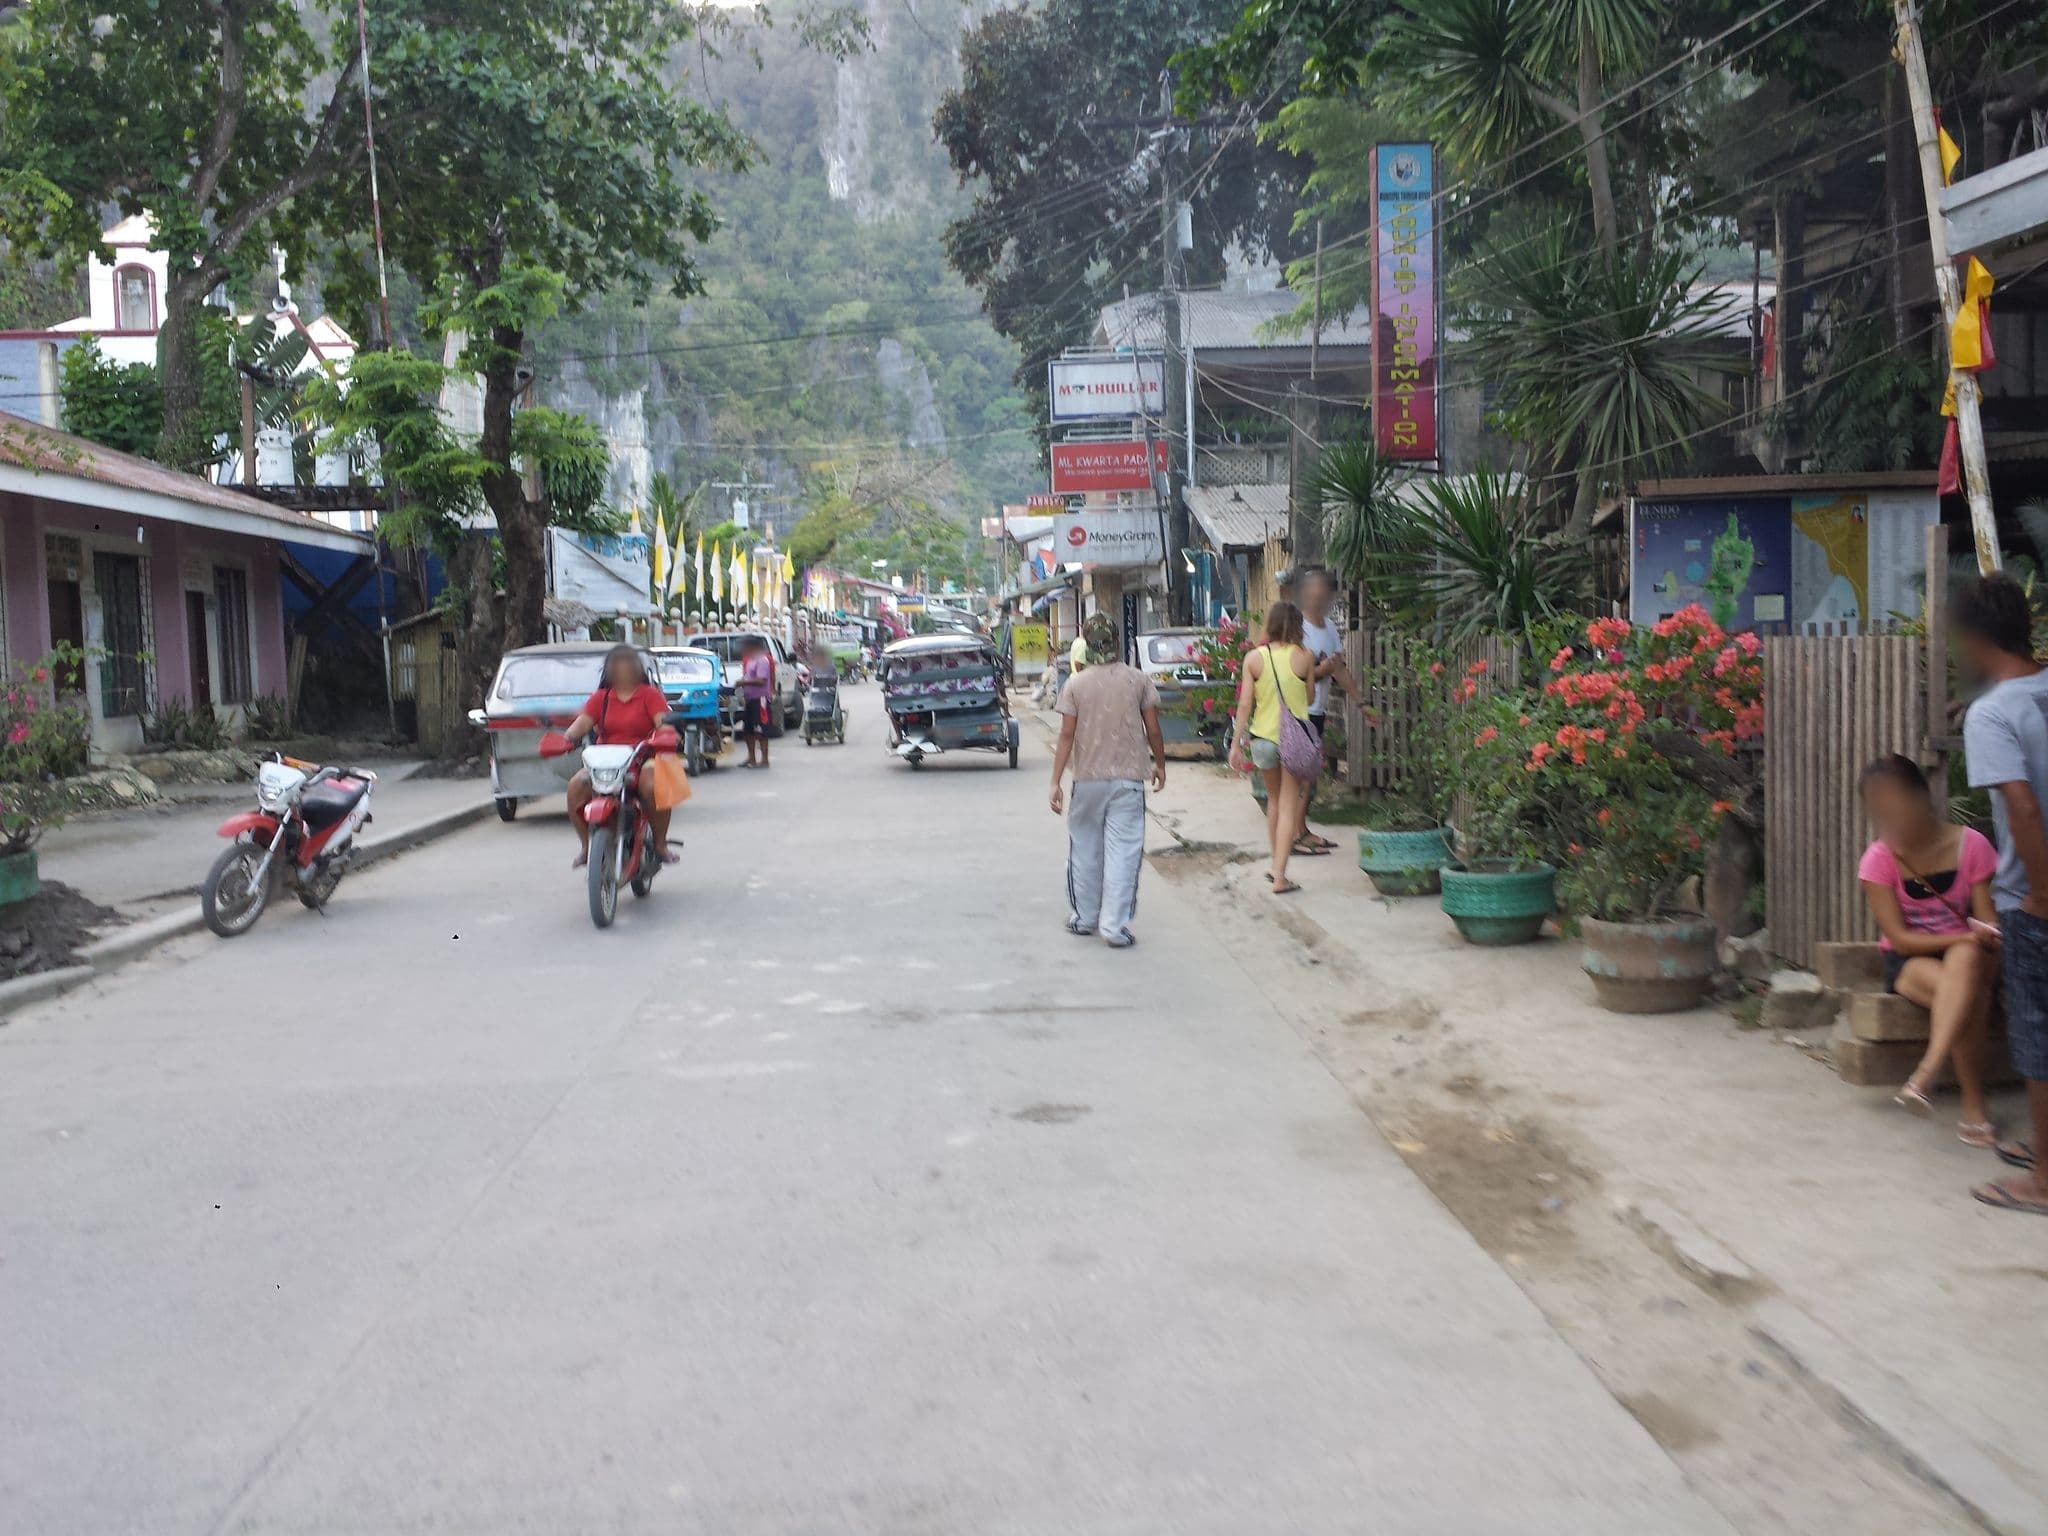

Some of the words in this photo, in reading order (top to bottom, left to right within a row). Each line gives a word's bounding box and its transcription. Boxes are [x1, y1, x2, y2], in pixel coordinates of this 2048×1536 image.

[1392, 202, 1416, 294] TOURIST
[1390, 303, 1420, 445] INFORMATION
[1058, 457, 1073, 469] ML
[1076, 455, 1120, 467] KWARTA
[1123, 453, 1163, 465] PADAA
[1089, 530, 1156, 544] MoneyGram
